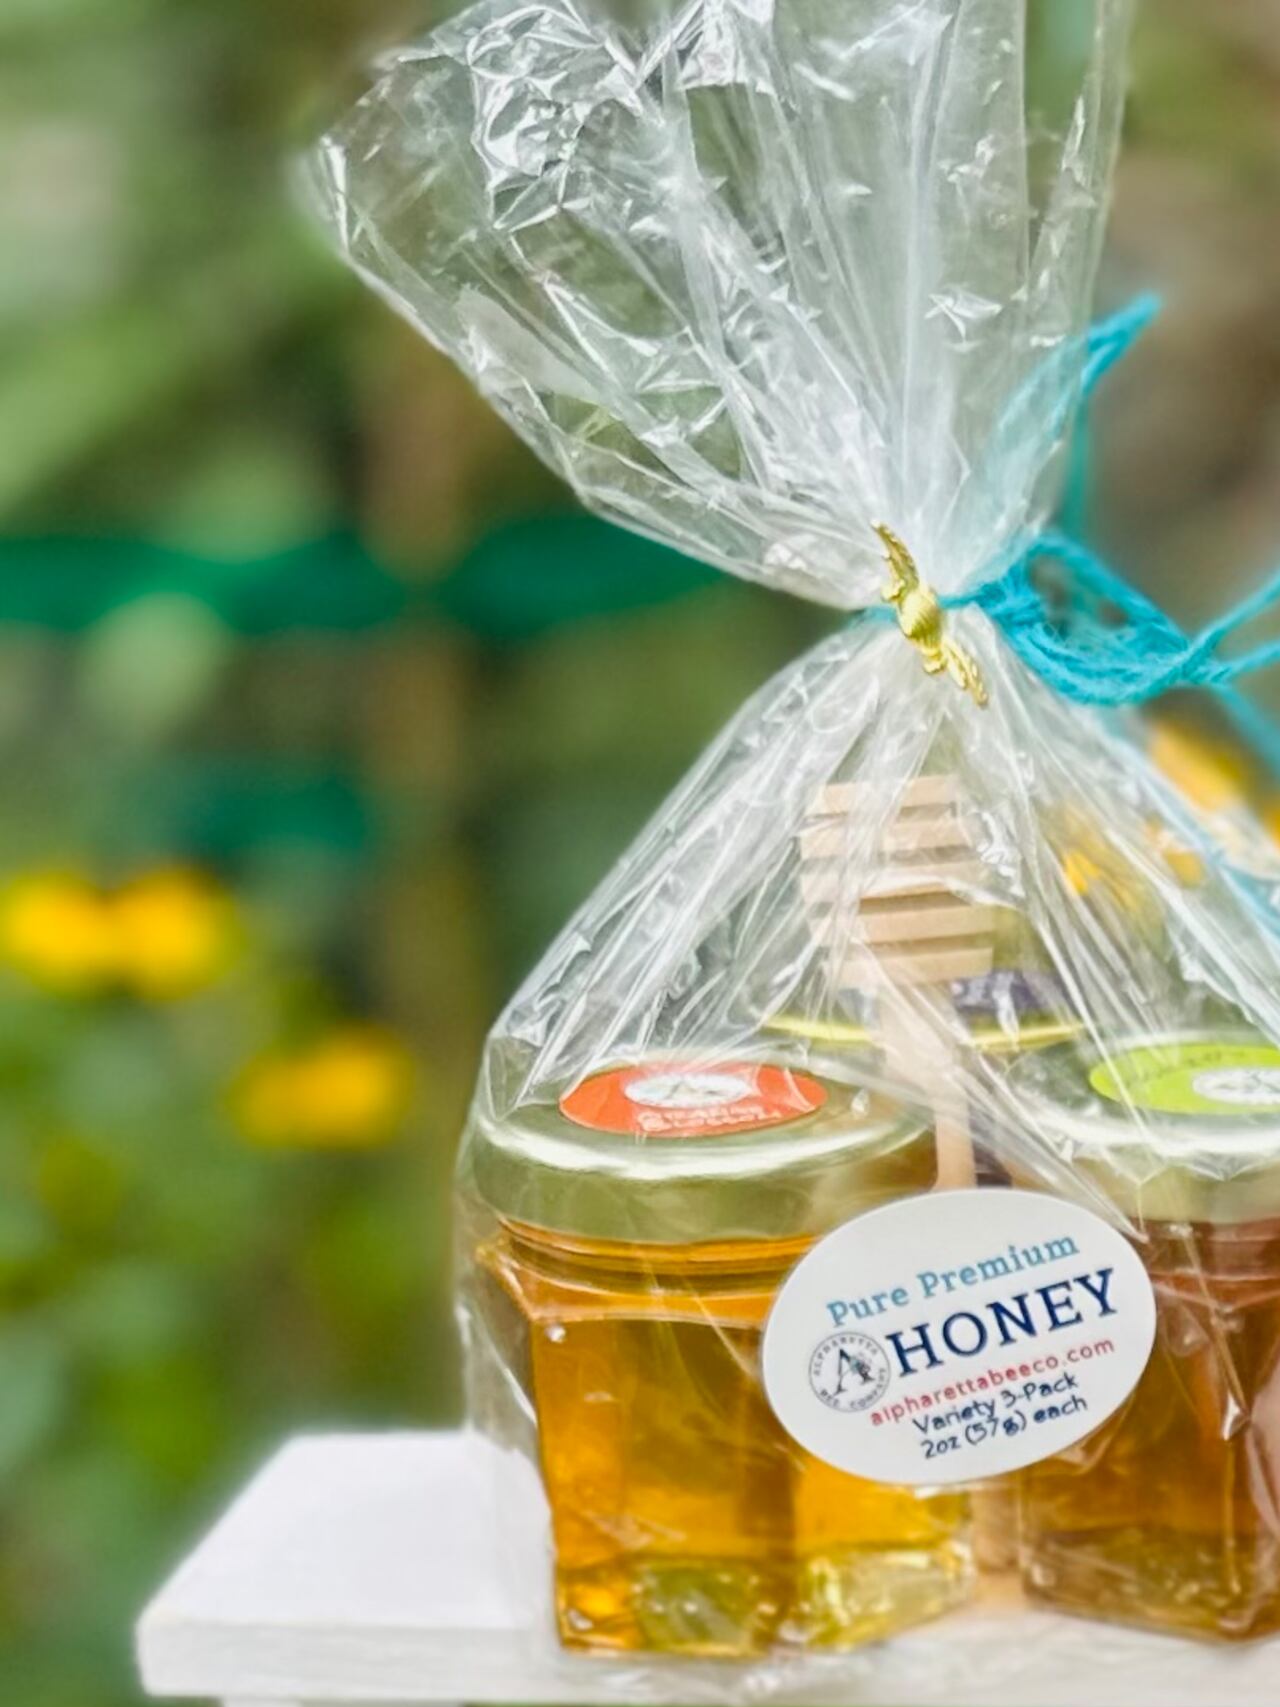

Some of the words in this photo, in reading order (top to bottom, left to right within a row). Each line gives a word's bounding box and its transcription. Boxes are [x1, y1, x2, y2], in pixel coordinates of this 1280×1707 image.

[827, 1287, 910, 1327] Pure
[917, 1235, 1079, 1299] Premium
[886, 1268, 1117, 1378] HONEY
[870, 1337, 1115, 1426] alpharettabeeco.com
[913, 1398, 996, 1435] Variety
[1004, 1372, 1079, 1409] 3-Pack
[921, 1434, 961, 1459] 2oz
[1034, 1397, 1087, 1424] each
